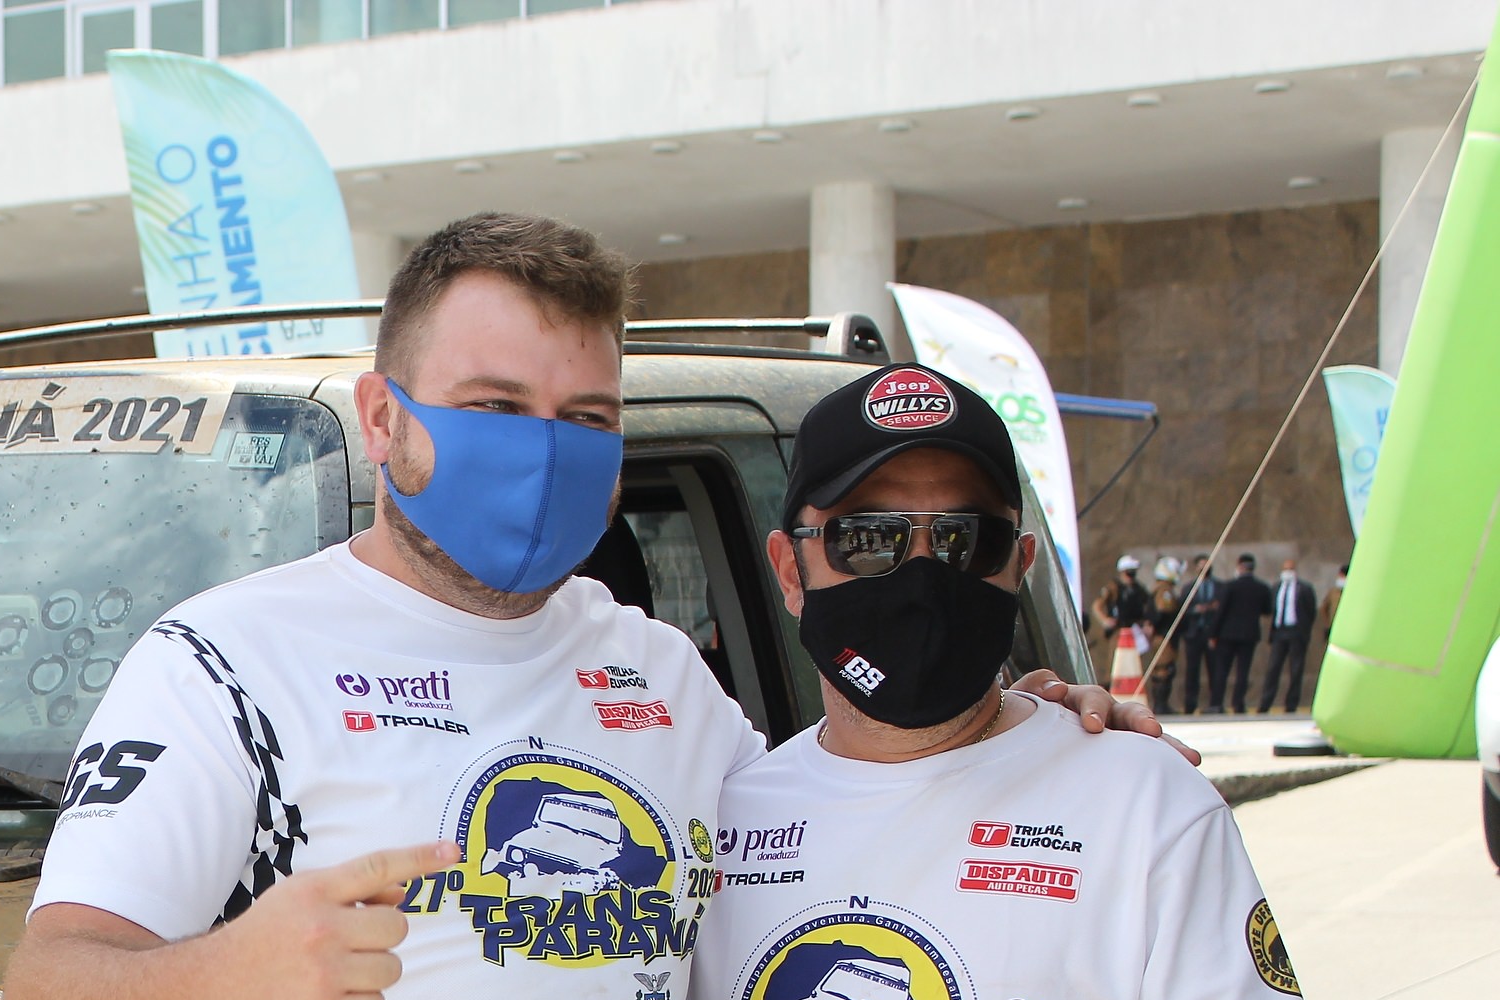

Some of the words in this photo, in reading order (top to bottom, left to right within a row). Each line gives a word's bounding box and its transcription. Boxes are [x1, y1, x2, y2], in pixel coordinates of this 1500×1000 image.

[871, 397, 948, 418] WILLYS
[72, 395, 209, 443] 2021
[886, 414, 940, 426] SERVICE
[602, 665, 638, 677] TRILHA
[844, 655, 886, 691] GS
[376, 669, 451, 705] prati
[404, 699, 454, 711] donaduzzi
[598, 703, 668, 720] DISPAUTO
[376, 714, 471, 736] TROLLER
[527, 735, 545, 750] N
[611, 778, 629, 792] um
[631, 791, 667, 835] desafio
[741, 820, 808, 862] prati
[1014, 824, 1065, 837] TRILHA
[756, 849, 800, 861] donaduzzi
[1010, 836, 1083, 853] EUROCAR
[687, 867, 714, 899] 202
[724, 870, 805, 887] TROLLER
[966, 864, 1074, 887] DISPAUTO
[986, 881, 1014, 892] AUTO
[460, 887, 676, 932] TRANS
[849, 895, 870, 910] N
[482, 901, 706, 966] PARANÁ
[777, 929, 802, 949] uma
[923, 943, 941, 961] um
